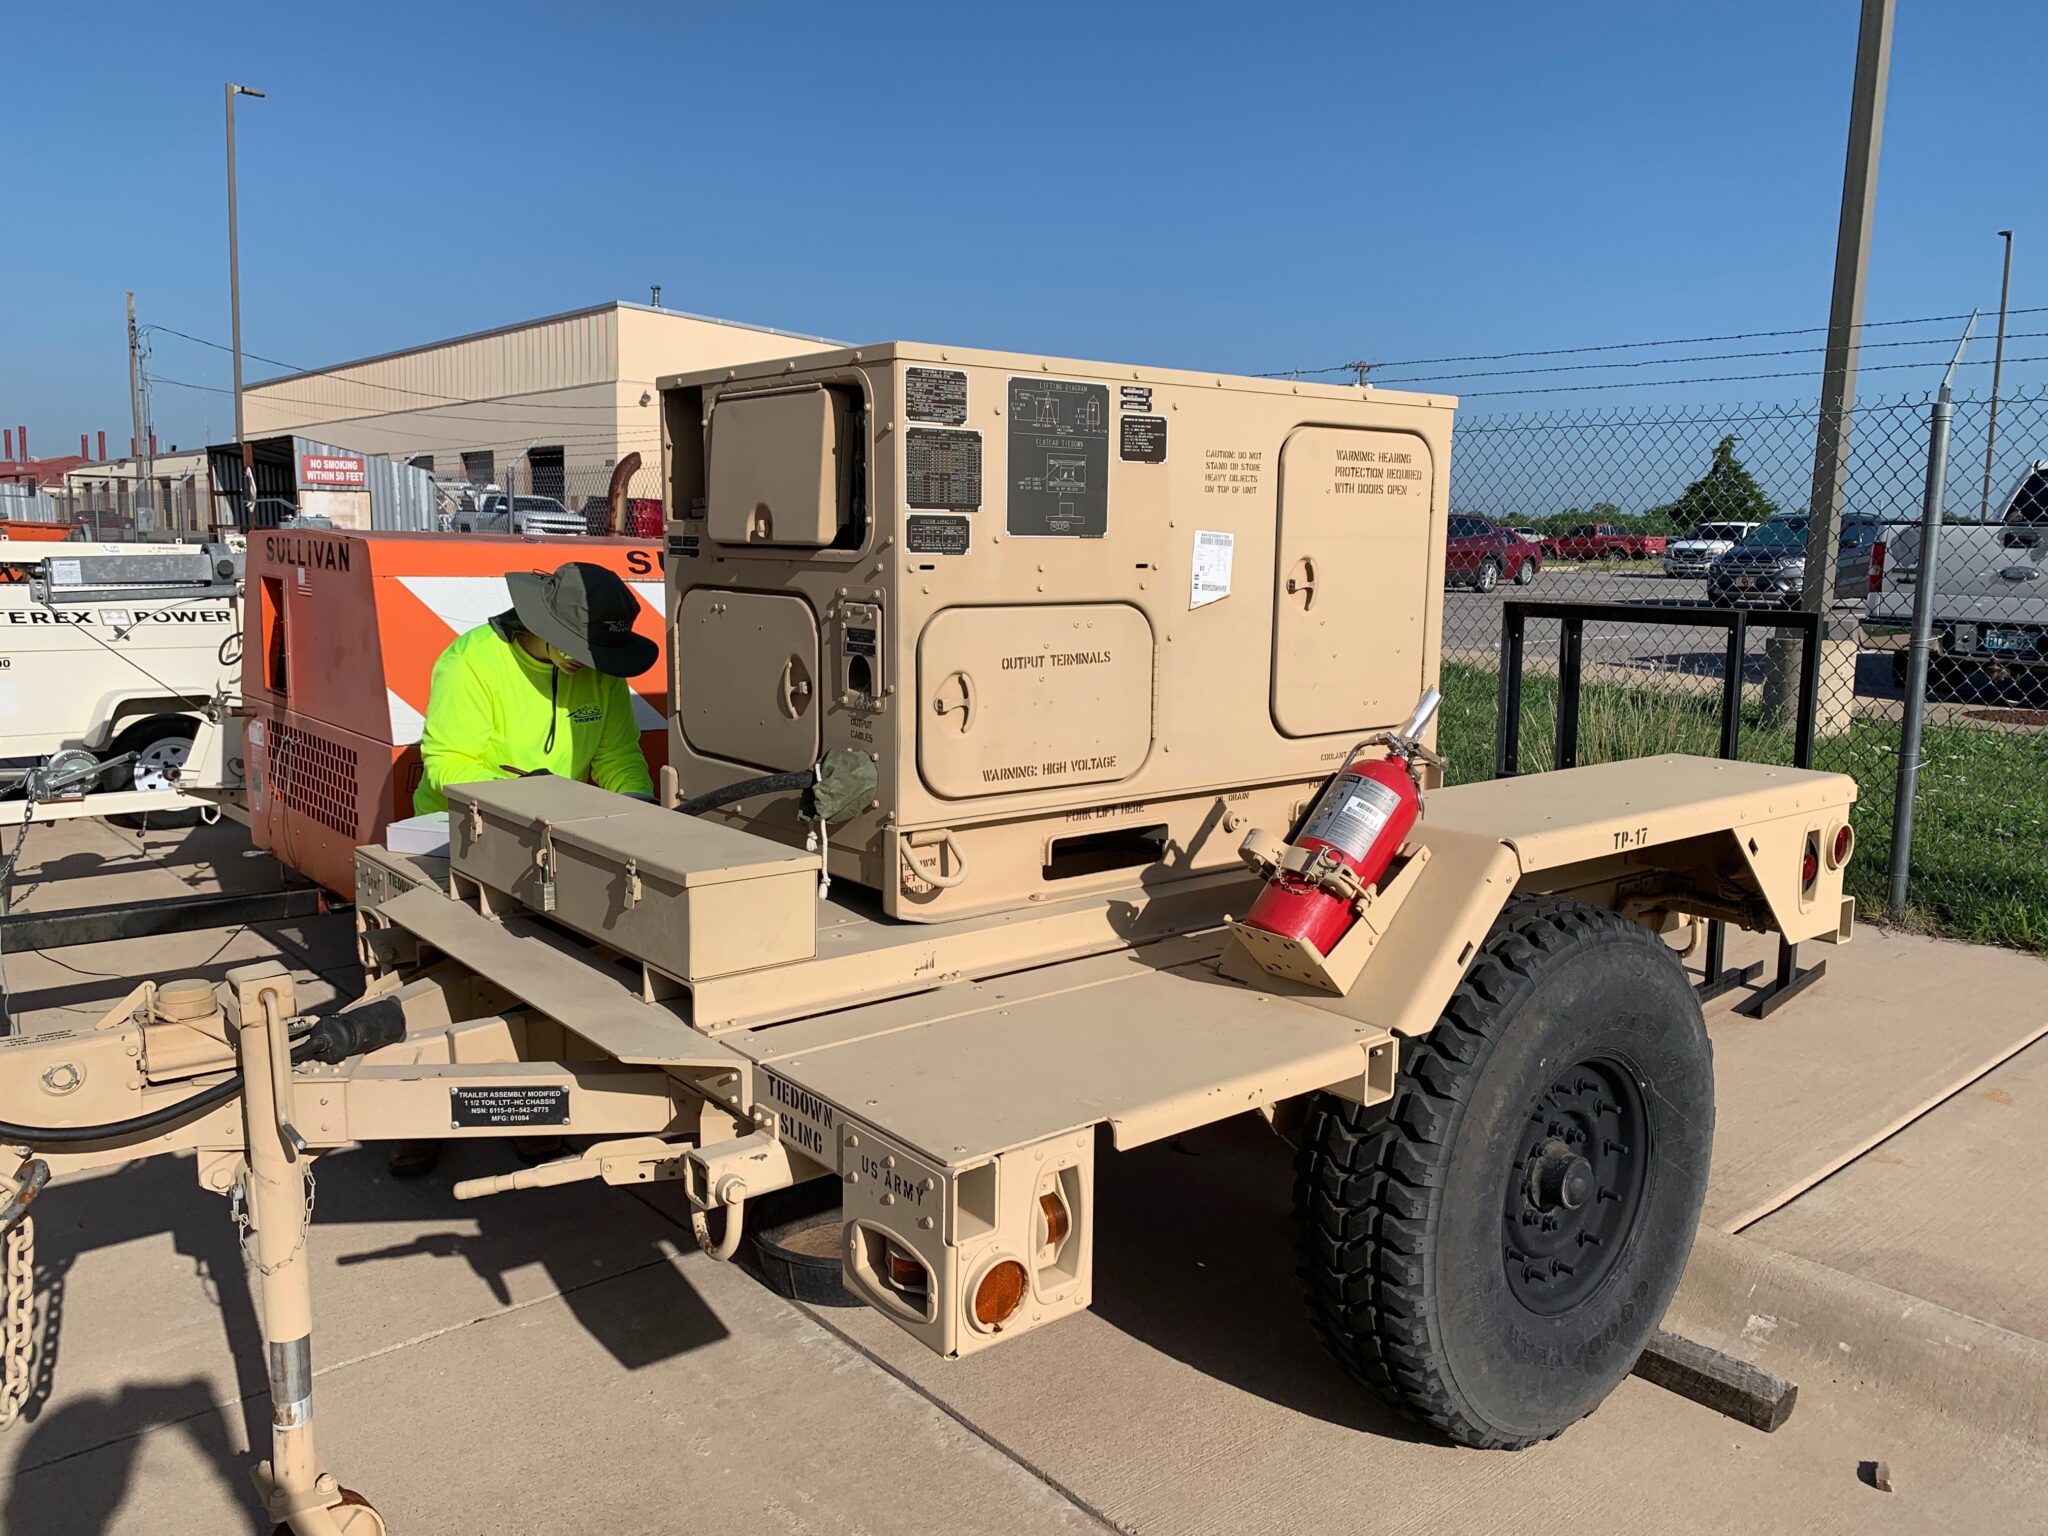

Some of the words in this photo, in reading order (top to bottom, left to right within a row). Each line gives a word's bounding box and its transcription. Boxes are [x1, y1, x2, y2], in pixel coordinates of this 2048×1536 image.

[1205, 450, 1236, 459] CAUTION:
[1238, 451, 1247, 459] DO
[1249, 452, 1262, 460] NOT
[1336, 450, 1375, 462] WARNING:
[1378, 452, 1411, 464] HEARING
[310, 459, 322, 468] NO
[323, 460, 358, 470] SMOKING
[1205, 462, 1228, 470] STAND
[1241, 463, 1261, 471] STORE
[307, 471, 334, 481] WITHIN
[335, 471, 345, 480] 50
[346, 472, 364, 482] FEET
[1205, 473, 1227, 481] HEAVY
[1229, 474, 1258, 482] OBJECTS
[1335, 466, 1384, 479] PROTECTION
[1386, 468, 1422, 480] REQUIRED
[1205, 485, 1214, 493] ON
[1217, 485, 1229, 493] TOP
[1232, 486, 1240, 494] OF
[1243, 486, 1257, 495] UNIT
[1335, 482, 1355, 494] WITH
[1357, 483, 1384, 495] DOORS
[1387, 485, 1407, 495] OPEN
[266, 536, 350, 572] SULLIVAN
[134, 611, 230, 623] POWER
[1001, 655, 1046, 671] OUTPUT
[1050, 651, 1112, 667] TERMINALS
[850, 718, 872, 730] OUTPUT
[850, 730, 873, 743] CABLES
[1320, 751, 1347, 761] COOLANT
[982, 765, 1038, 783] WARNING:
[1042, 760, 1067, 776] HIGH
[1071, 756, 1117, 772] VOLTAGE
[1228, 791, 1250, 802] DRAIN
[1066, 808, 1092, 823] FORK
[1096, 805, 1117, 819] LIFT
[1120, 801, 1145, 816] HERE
[1613, 827, 1648, 850] TP-17
[767, 1074, 833, 1130] TIEDOWN
[780, 1112, 823, 1155] SLING
[861, 1155, 878, 1179] US
[884, 1170, 925, 1206] ARMY
